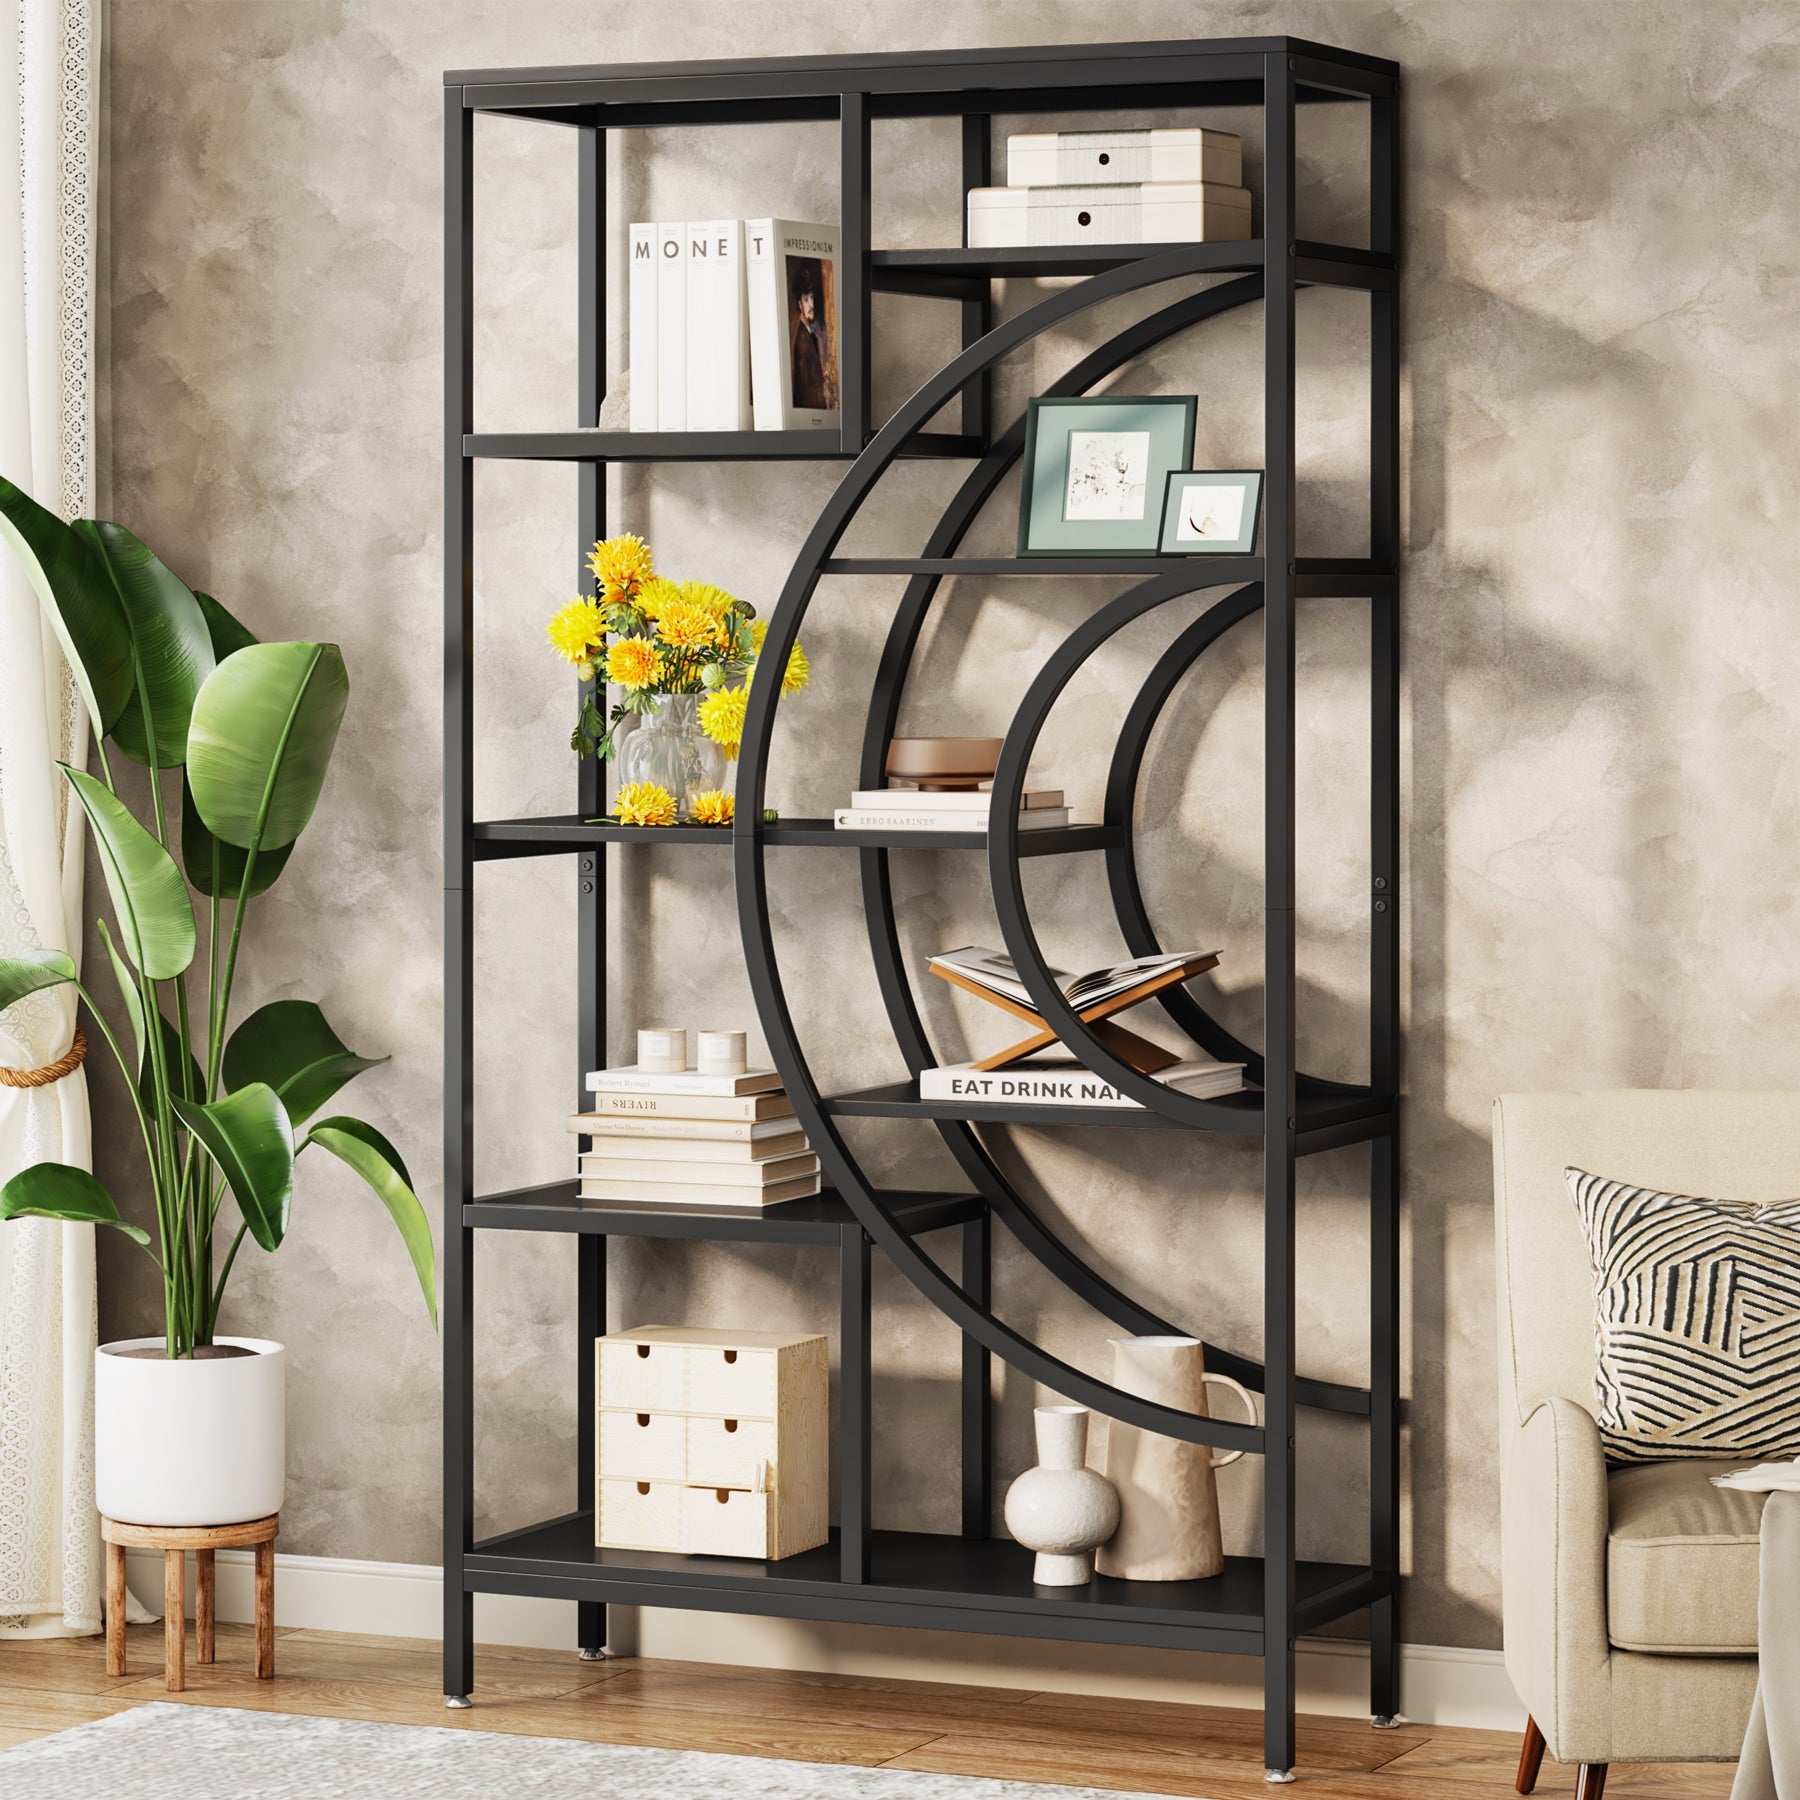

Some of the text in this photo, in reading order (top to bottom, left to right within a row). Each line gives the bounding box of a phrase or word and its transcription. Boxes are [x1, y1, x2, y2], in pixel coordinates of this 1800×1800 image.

[784, 238, 833, 253] IMPRESSIONISM
[860, 817, 936, 826] EERO SAARINEN
[951, 1079, 993, 1095] EAT
[1001, 1081, 1073, 1098] DRINK
[612, 1099, 657, 1110] RIVERS
